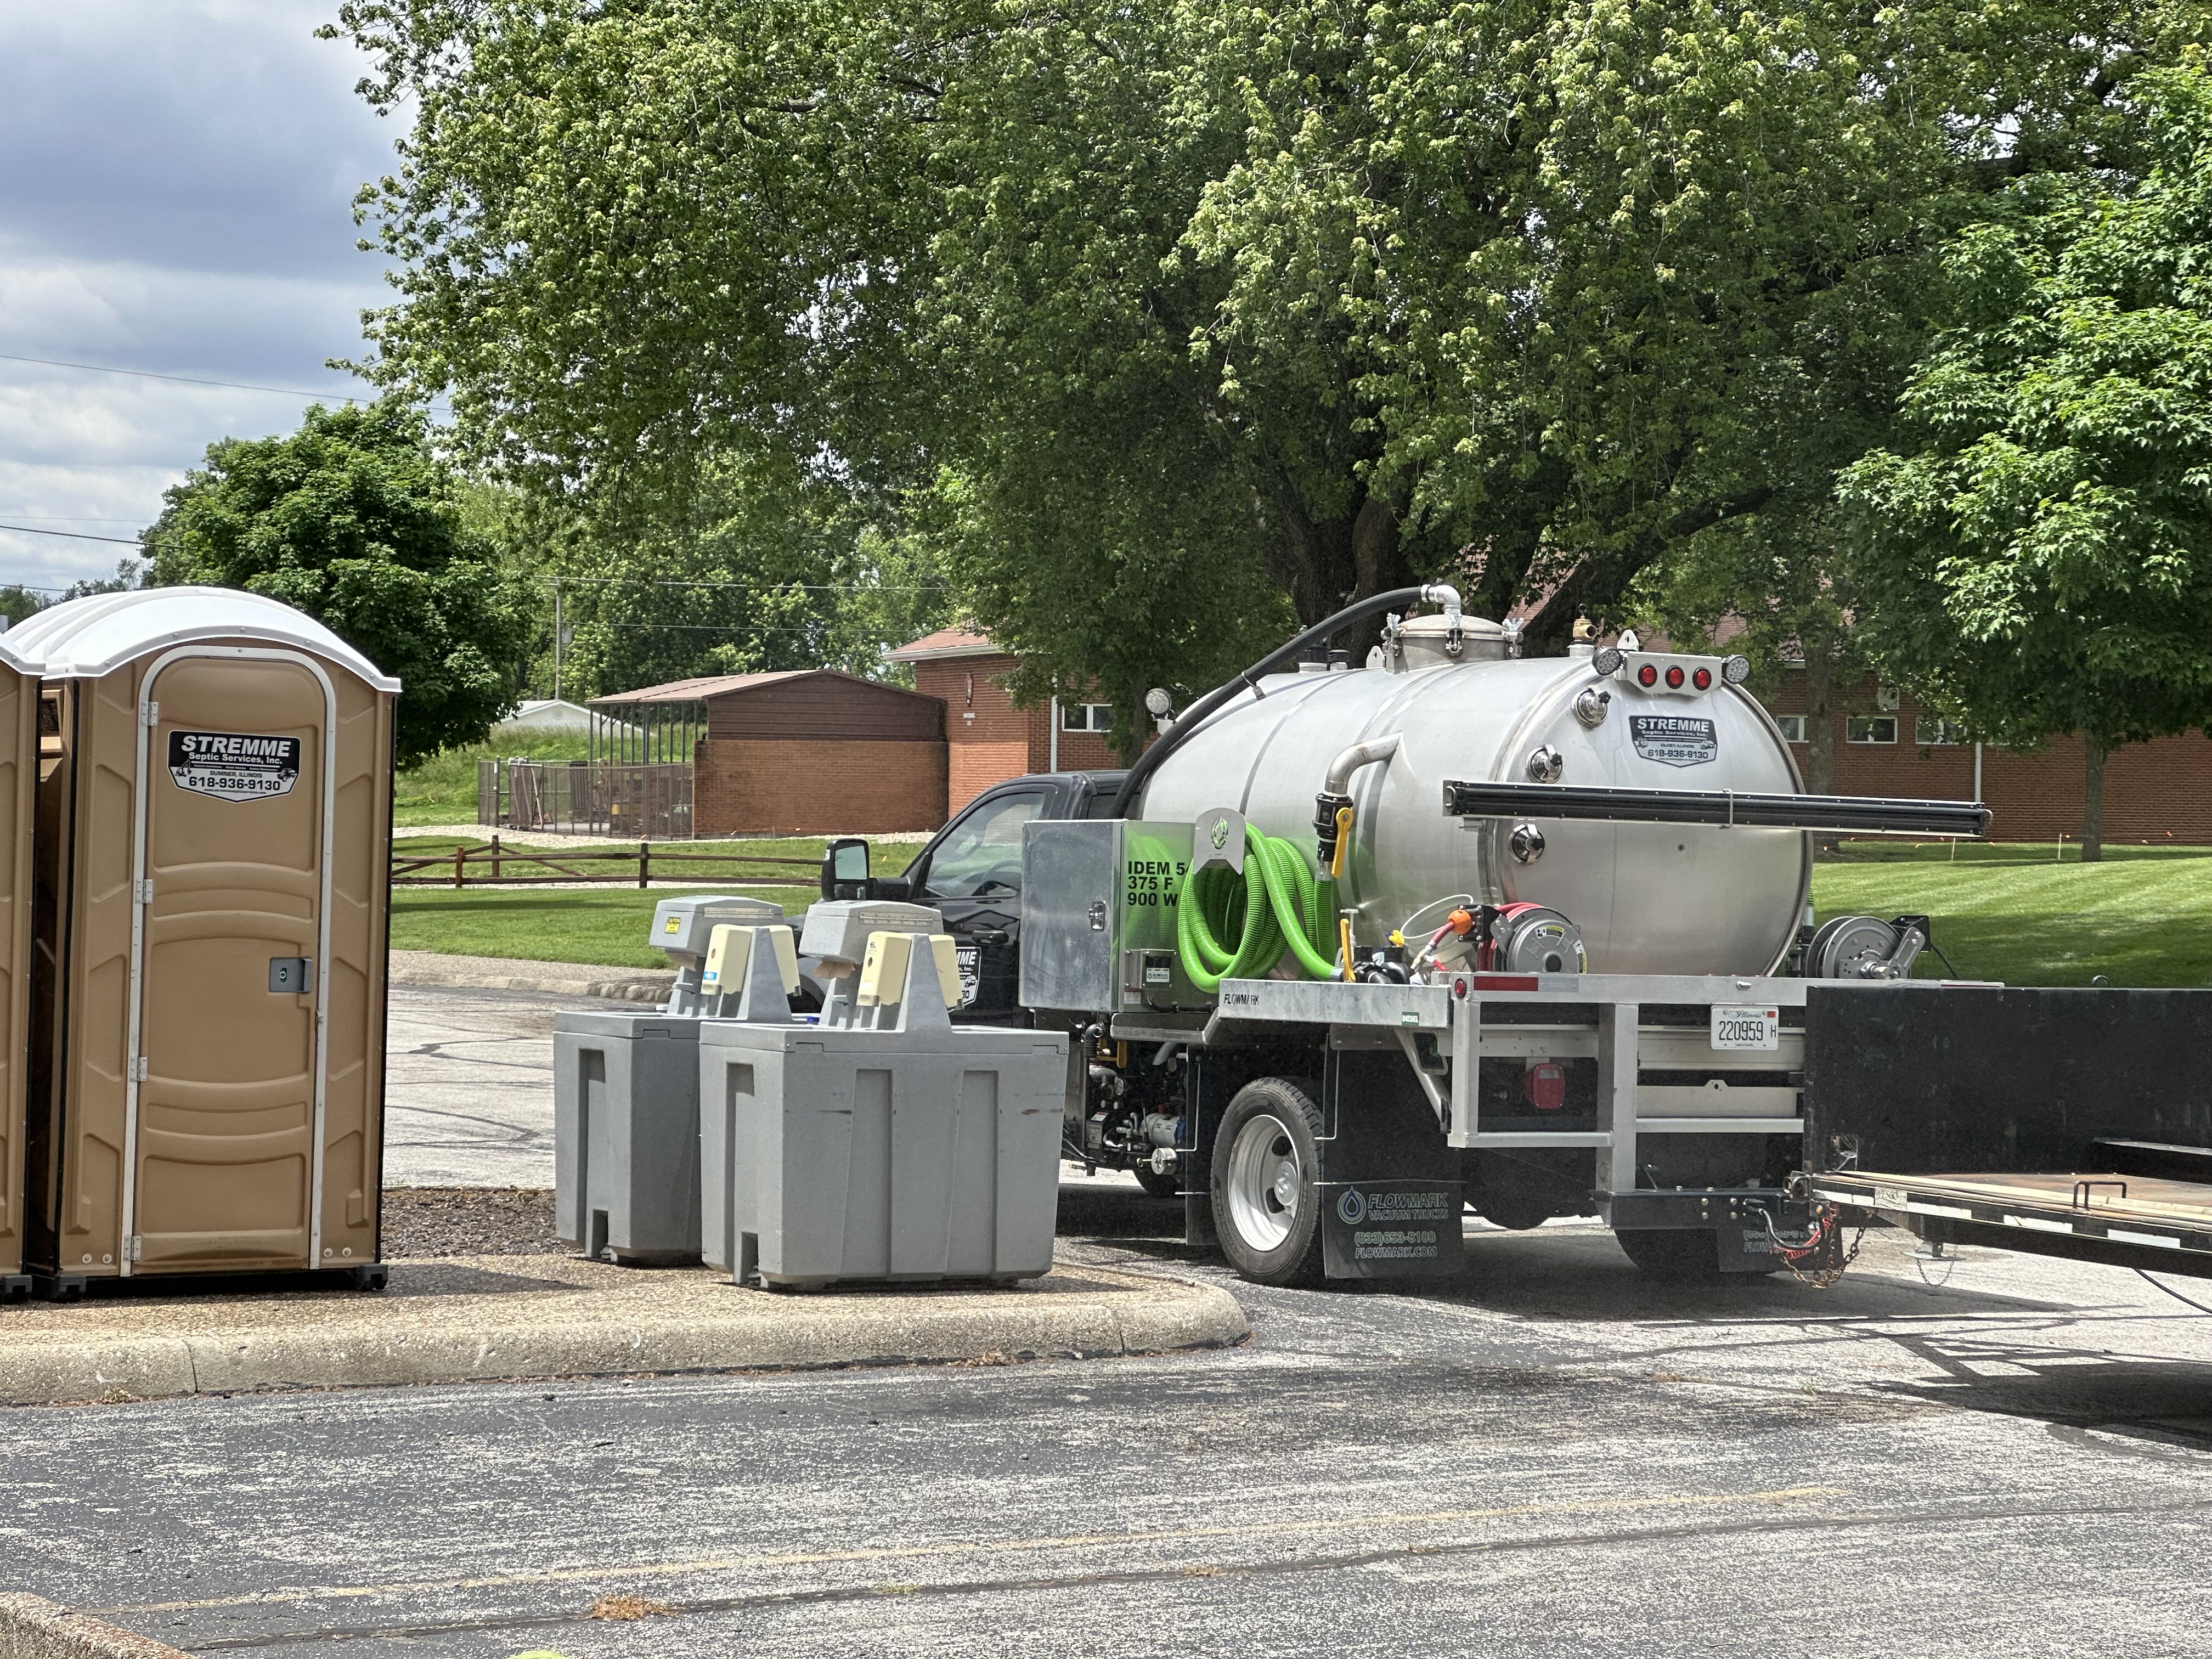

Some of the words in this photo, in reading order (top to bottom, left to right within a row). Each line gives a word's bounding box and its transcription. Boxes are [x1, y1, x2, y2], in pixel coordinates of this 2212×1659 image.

[1637, 718, 1709, 732] STREMME
[182, 736, 291, 757] STREMME
[189, 752, 219, 761] Septic
[222, 754, 264, 764] Services,
[1648, 749, 1708, 759] 618-936-9130
[189, 776, 280, 791] 618-936-9130
[1128, 861, 1170, 875] IDEM
[1176, 862, 1190, 875] 5
[1128, 876, 1158, 890] 375
[1164, 877, 1173, 890] F
[1127, 892, 1158, 906] 900
[1163, 893, 1178, 906] W
[1719, 1021, 1763, 1041] 220959
[1770, 1025, 1776, 1037] H
[1368, 1193, 1448, 1208] FLOWMARK
[1368, 1209, 1411, 1221] VACUUM
[1412, 1209, 1449, 1220] TRUCKS
[1354, 1231, 1436, 1247] (833)653-8100
[1355, 1246, 1438, 1259] FLOWMARK.COM
